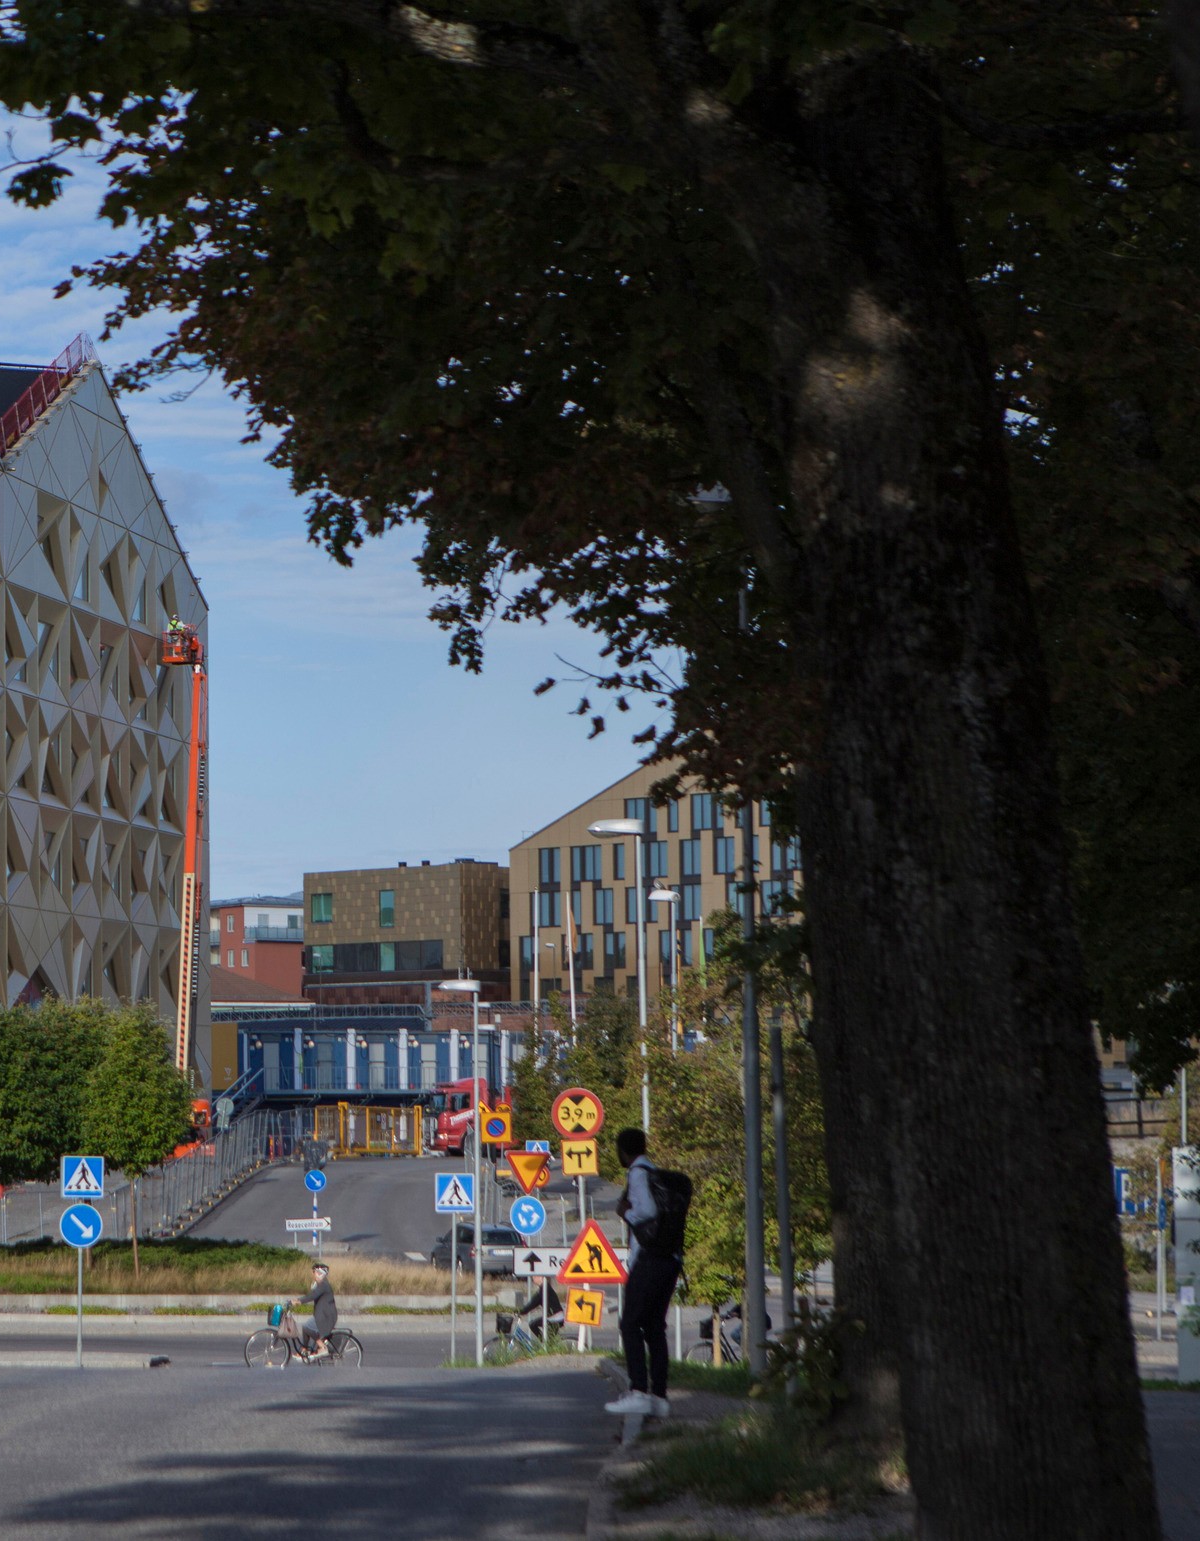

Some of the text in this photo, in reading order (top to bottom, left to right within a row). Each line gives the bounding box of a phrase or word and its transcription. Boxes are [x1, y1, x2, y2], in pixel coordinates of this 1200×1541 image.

[560, 1106, 596, 1122] 3,9 m
[287, 1220, 324, 1229] Resecentrum
